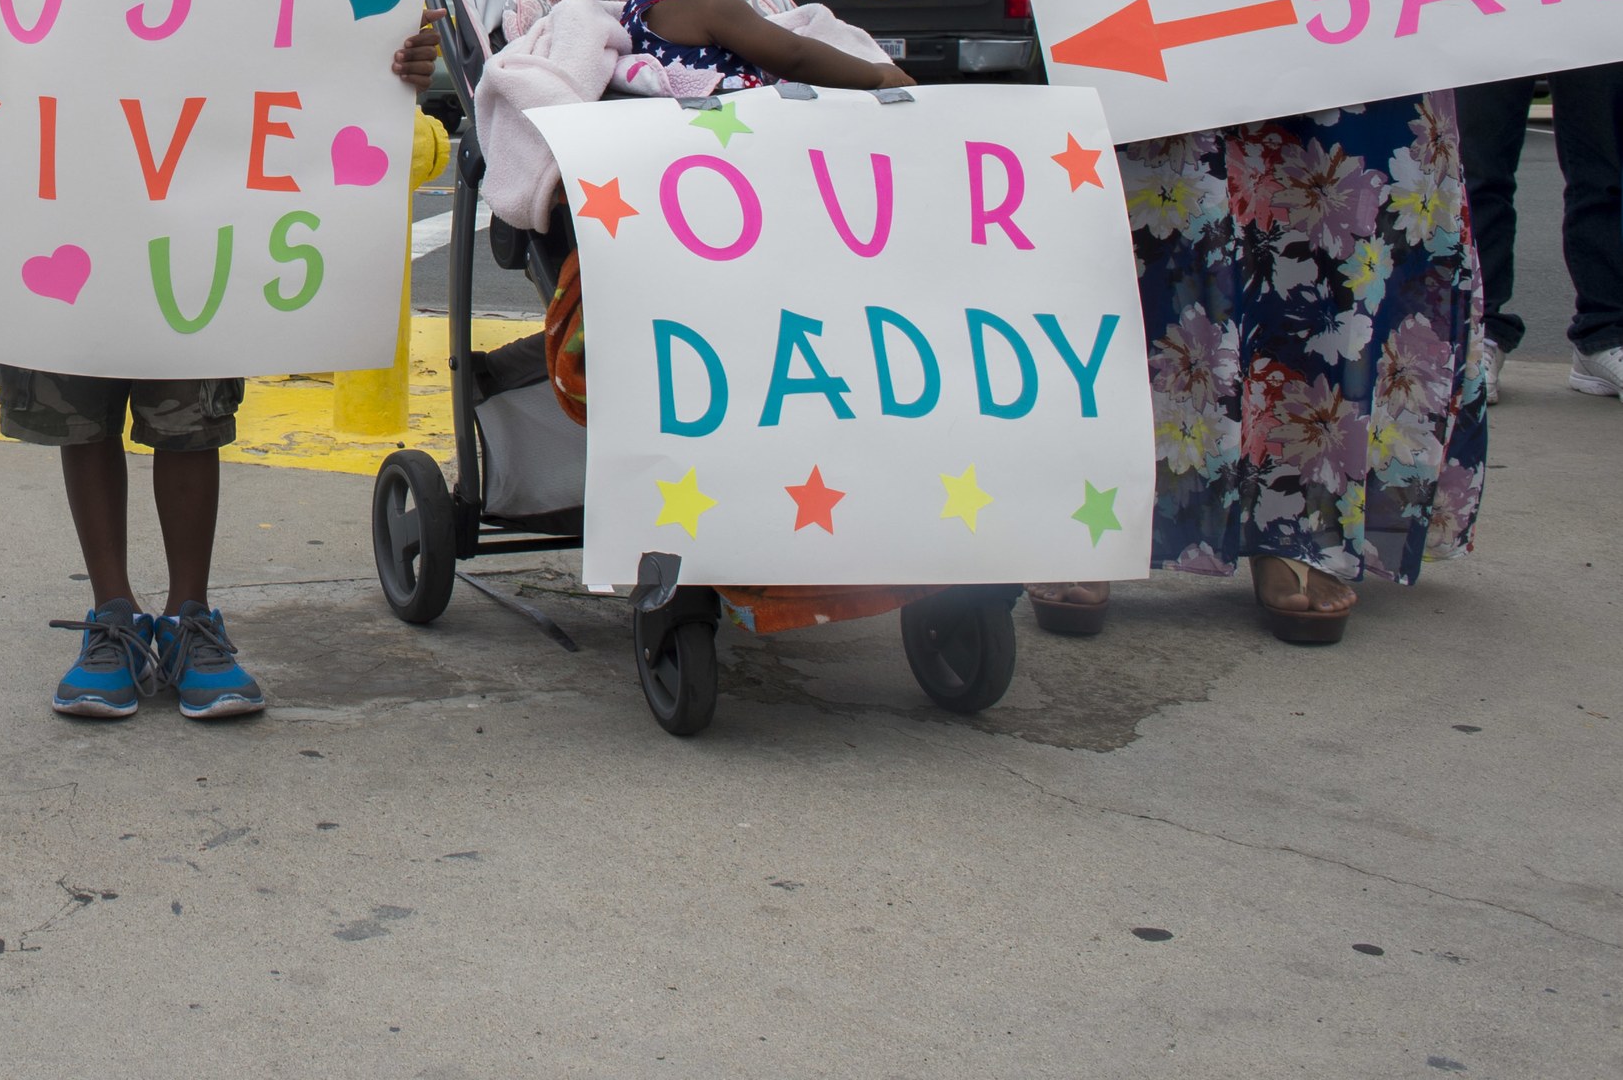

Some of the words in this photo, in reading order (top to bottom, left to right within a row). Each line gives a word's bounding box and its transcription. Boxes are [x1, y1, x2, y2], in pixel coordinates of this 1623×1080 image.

[659, 140, 1035, 261] OUR
[148, 210, 324, 334] US
[652, 305, 1121, 438] DADDY
